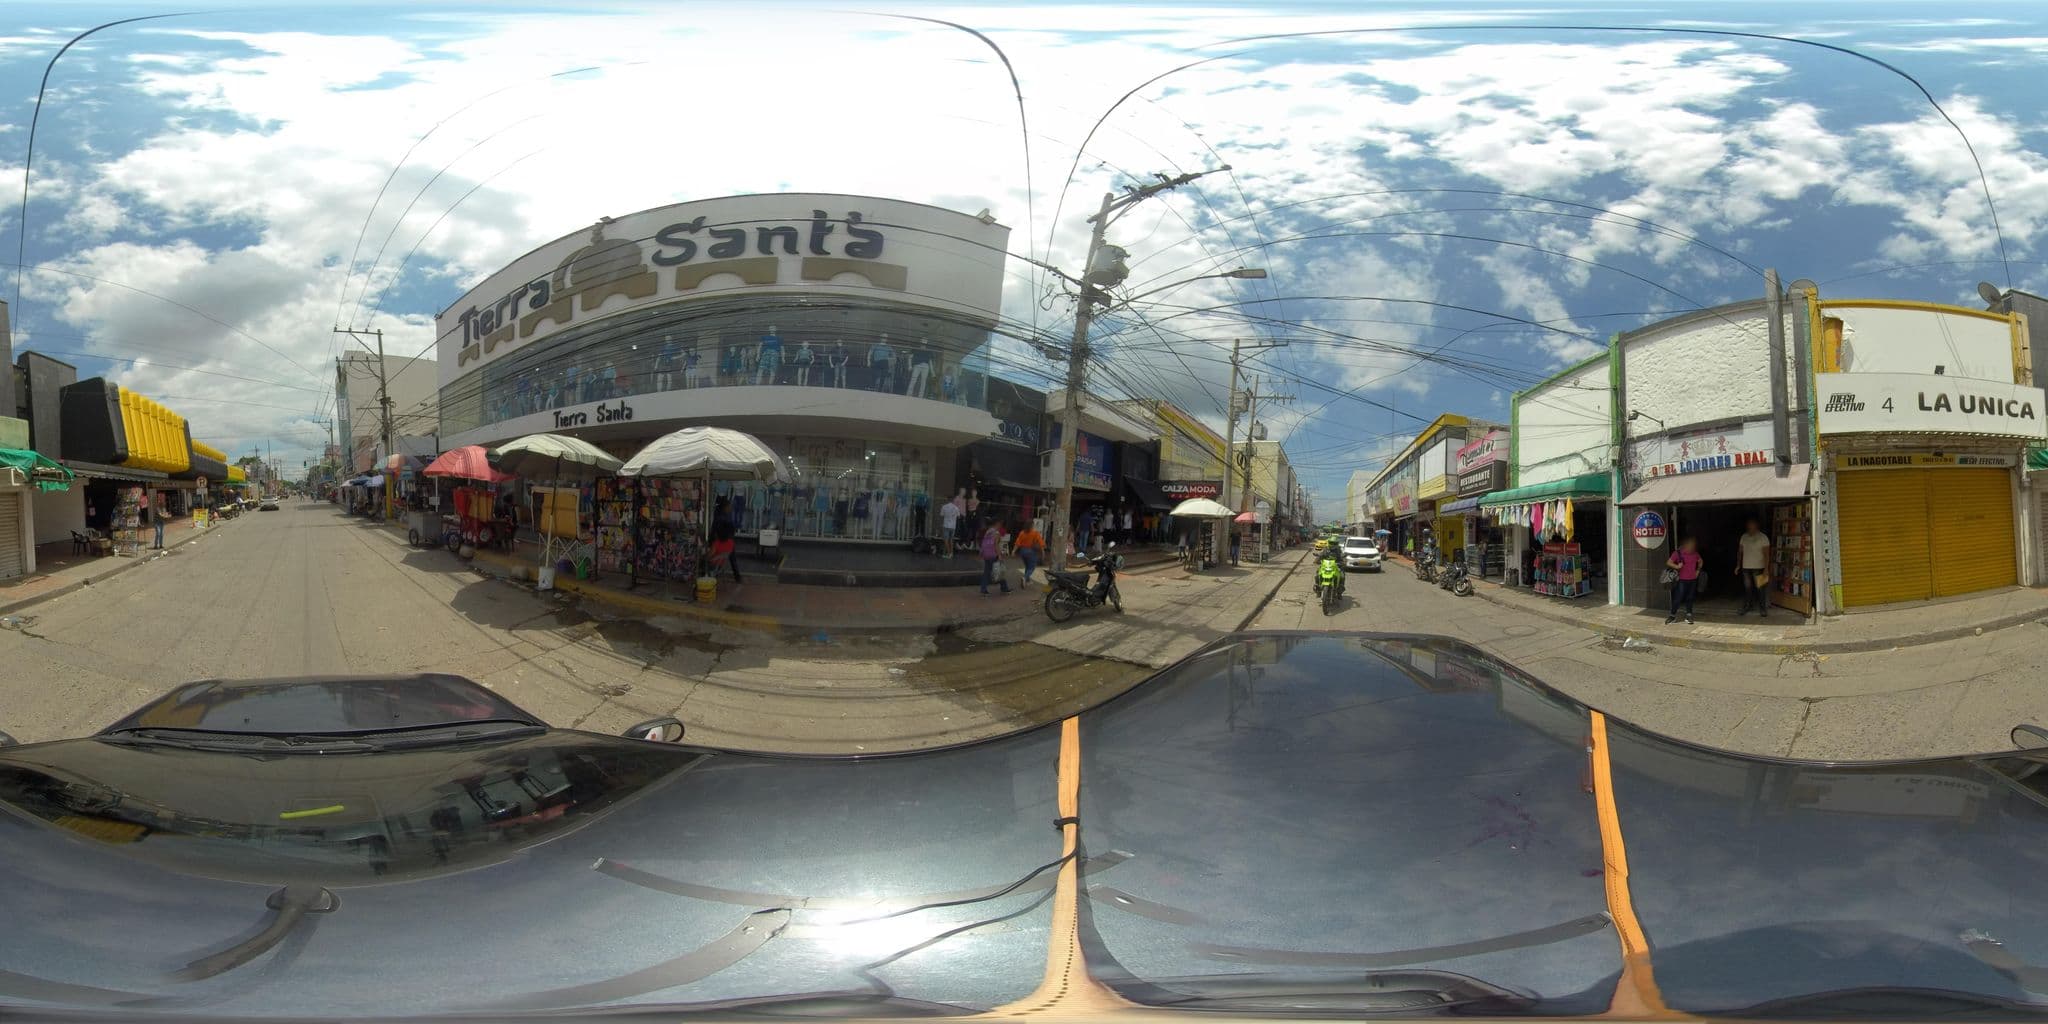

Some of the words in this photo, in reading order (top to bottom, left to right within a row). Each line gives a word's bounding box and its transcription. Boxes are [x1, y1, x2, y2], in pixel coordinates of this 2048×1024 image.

[458, 277, 550, 349] Tierra
[652, 210, 886, 266] Santa
[553, 410, 587, 429] Tierra
[597, 399, 633, 423] Santa
[1825, 402, 1865, 413] EFECTIVO
[1881, 397, 1894, 413] 4
[1918, 391, 1952, 412] LA
[1959, 395, 2035, 419] UNICA
[1680, 455, 1731, 473] LONDRES
[1734, 451, 1767, 465] REAL
[1848, 457, 1858, 467] LA
[1860, 456, 1912, 466] INAGOTABLE
[1635, 527, 1664, 537] HOTEL
